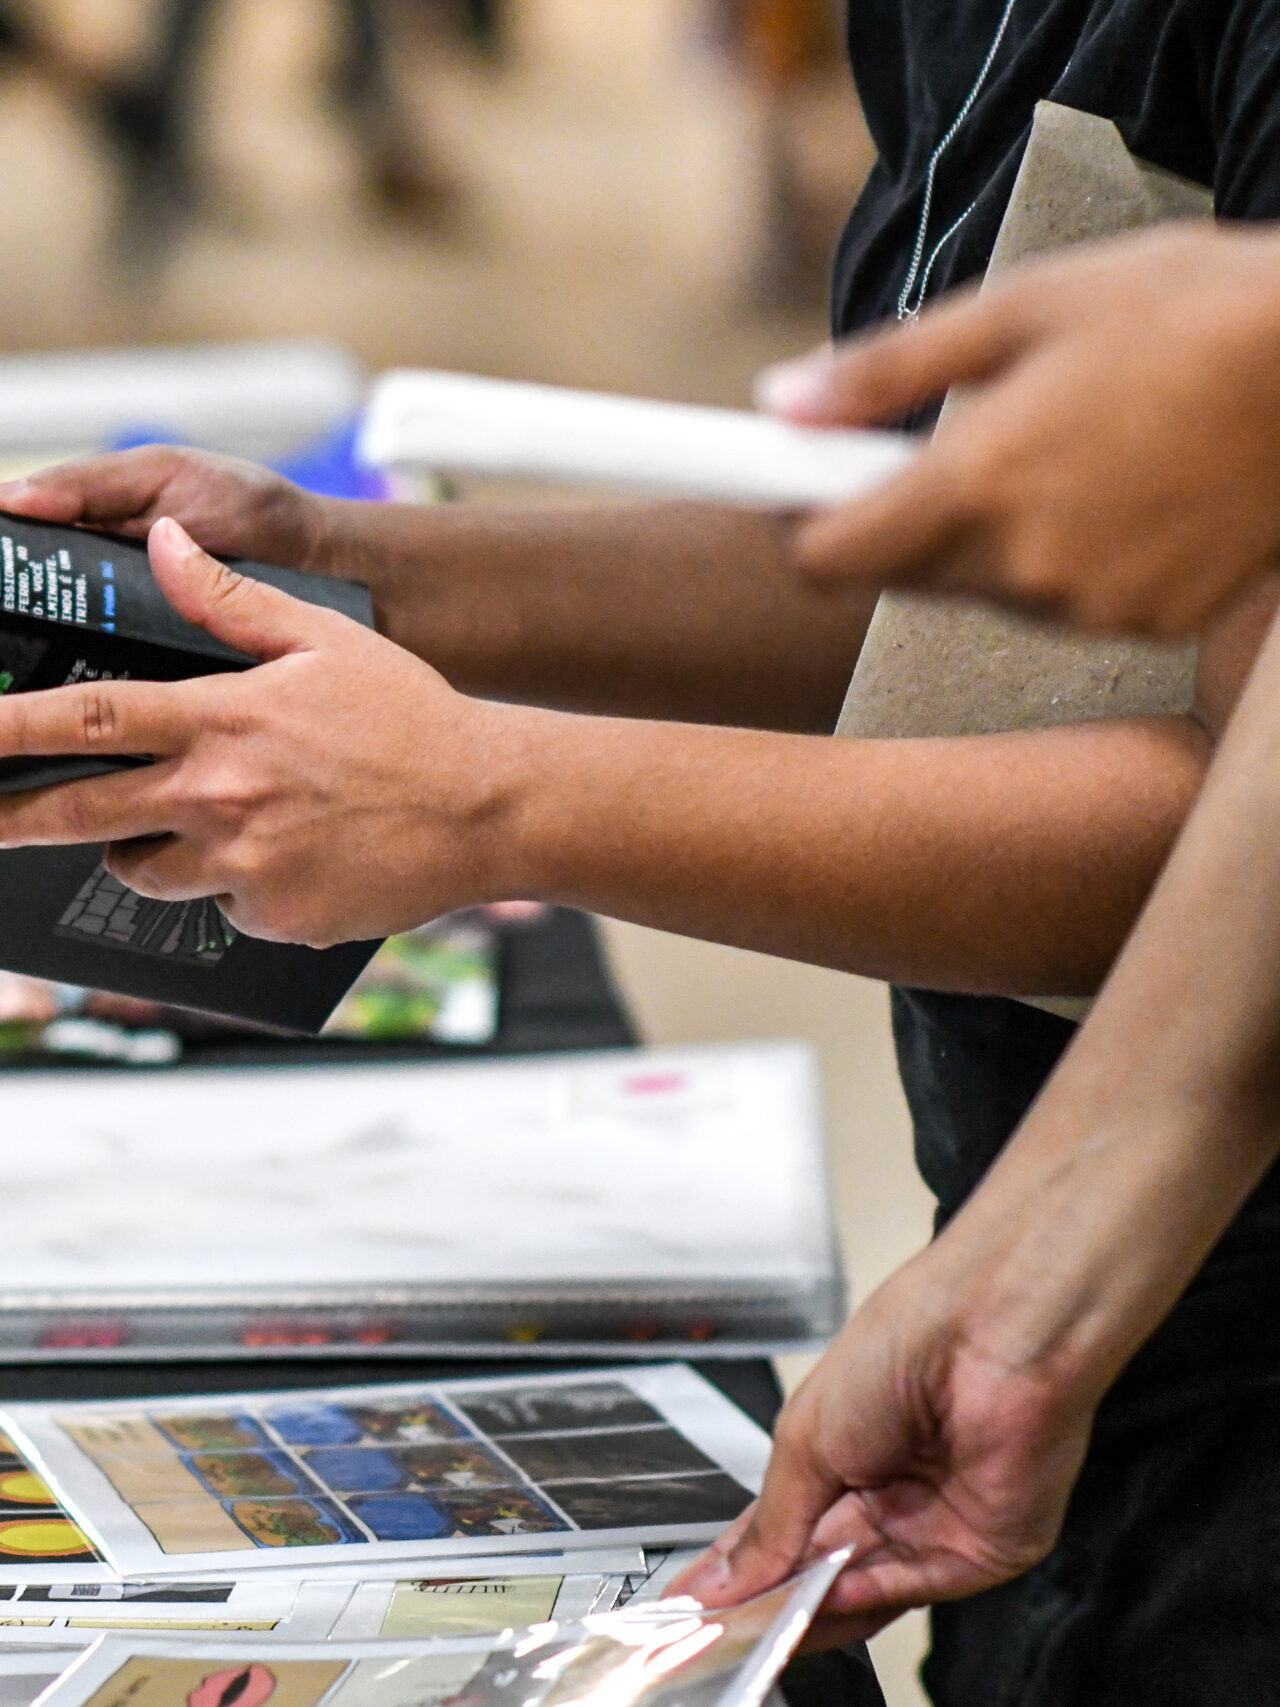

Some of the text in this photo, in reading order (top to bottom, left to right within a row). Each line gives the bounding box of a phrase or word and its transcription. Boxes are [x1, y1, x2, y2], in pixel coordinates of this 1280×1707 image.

[1, 536, 15, 610] ESSIONANDO
[46, 554, 58, 619] LMINANTE.
[61, 588, 73, 622] INDO
